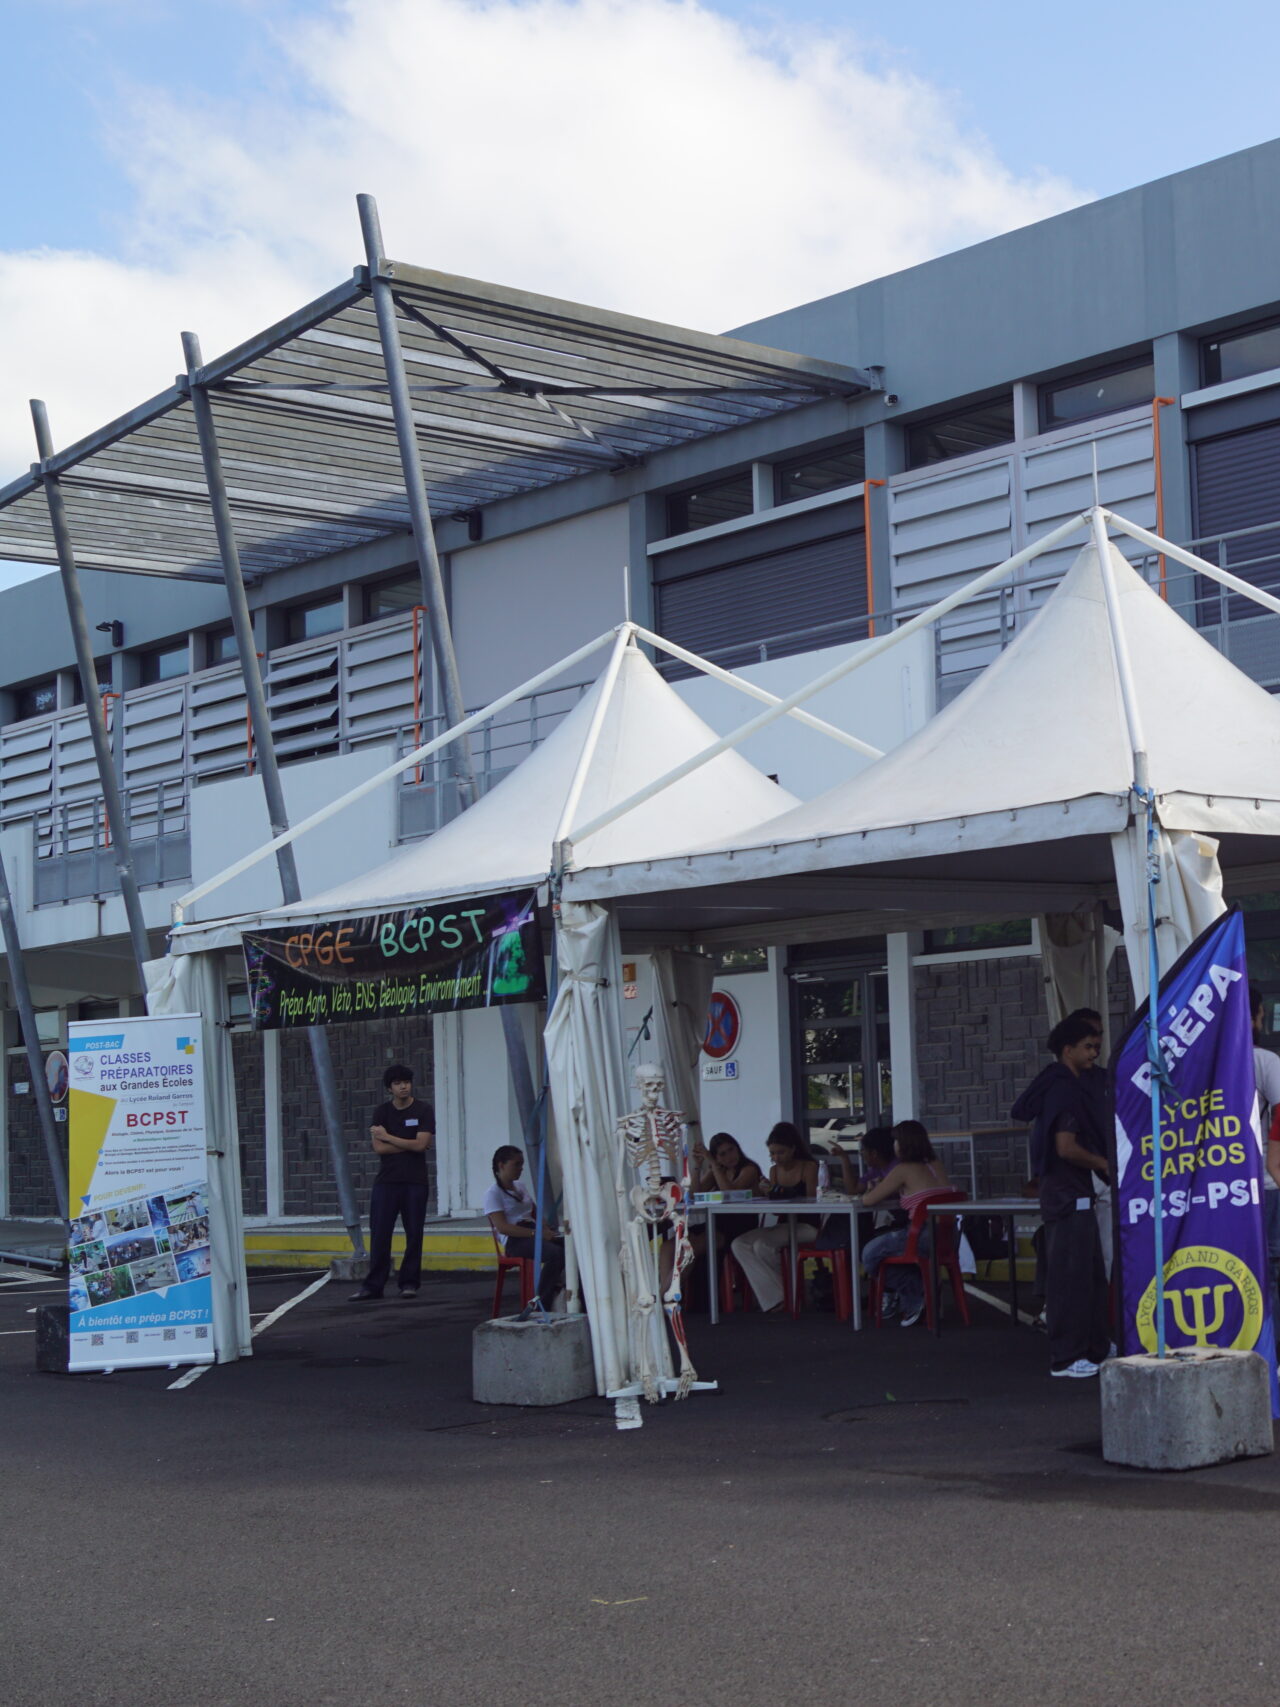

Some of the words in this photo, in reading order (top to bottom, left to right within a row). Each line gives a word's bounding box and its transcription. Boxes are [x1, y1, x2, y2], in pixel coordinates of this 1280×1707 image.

[285, 928, 354, 968] CPGE
[379, 909, 486, 957] BCPST
[280, 988, 303, 1024] Prépa
[305, 990, 329, 1023] Agro,
[331, 984, 354, 1014] Véto,
[355, 982, 377, 1012] ENS,
[379, 974, 417, 1014] Géologie,
[420, 972, 482, 1005] Environnement
[85, 1040, 120, 1050] POST-BAC
[100, 1052, 151, 1065] CLASSES
[100, 1064, 193, 1080] PRÉPARATOIRES
[100, 1084, 117, 1092] aux
[120, 1080, 160, 1091] Grandes
[162, 1075, 193, 1088] Écoles
[126, 1110, 189, 1128] BCPST
[88, 1315, 123, 1327] bientôt
[125, 1317, 136, 1325] en
[139, 1312, 166, 1325] prépa
[169, 1309, 203, 1321] BCPST
